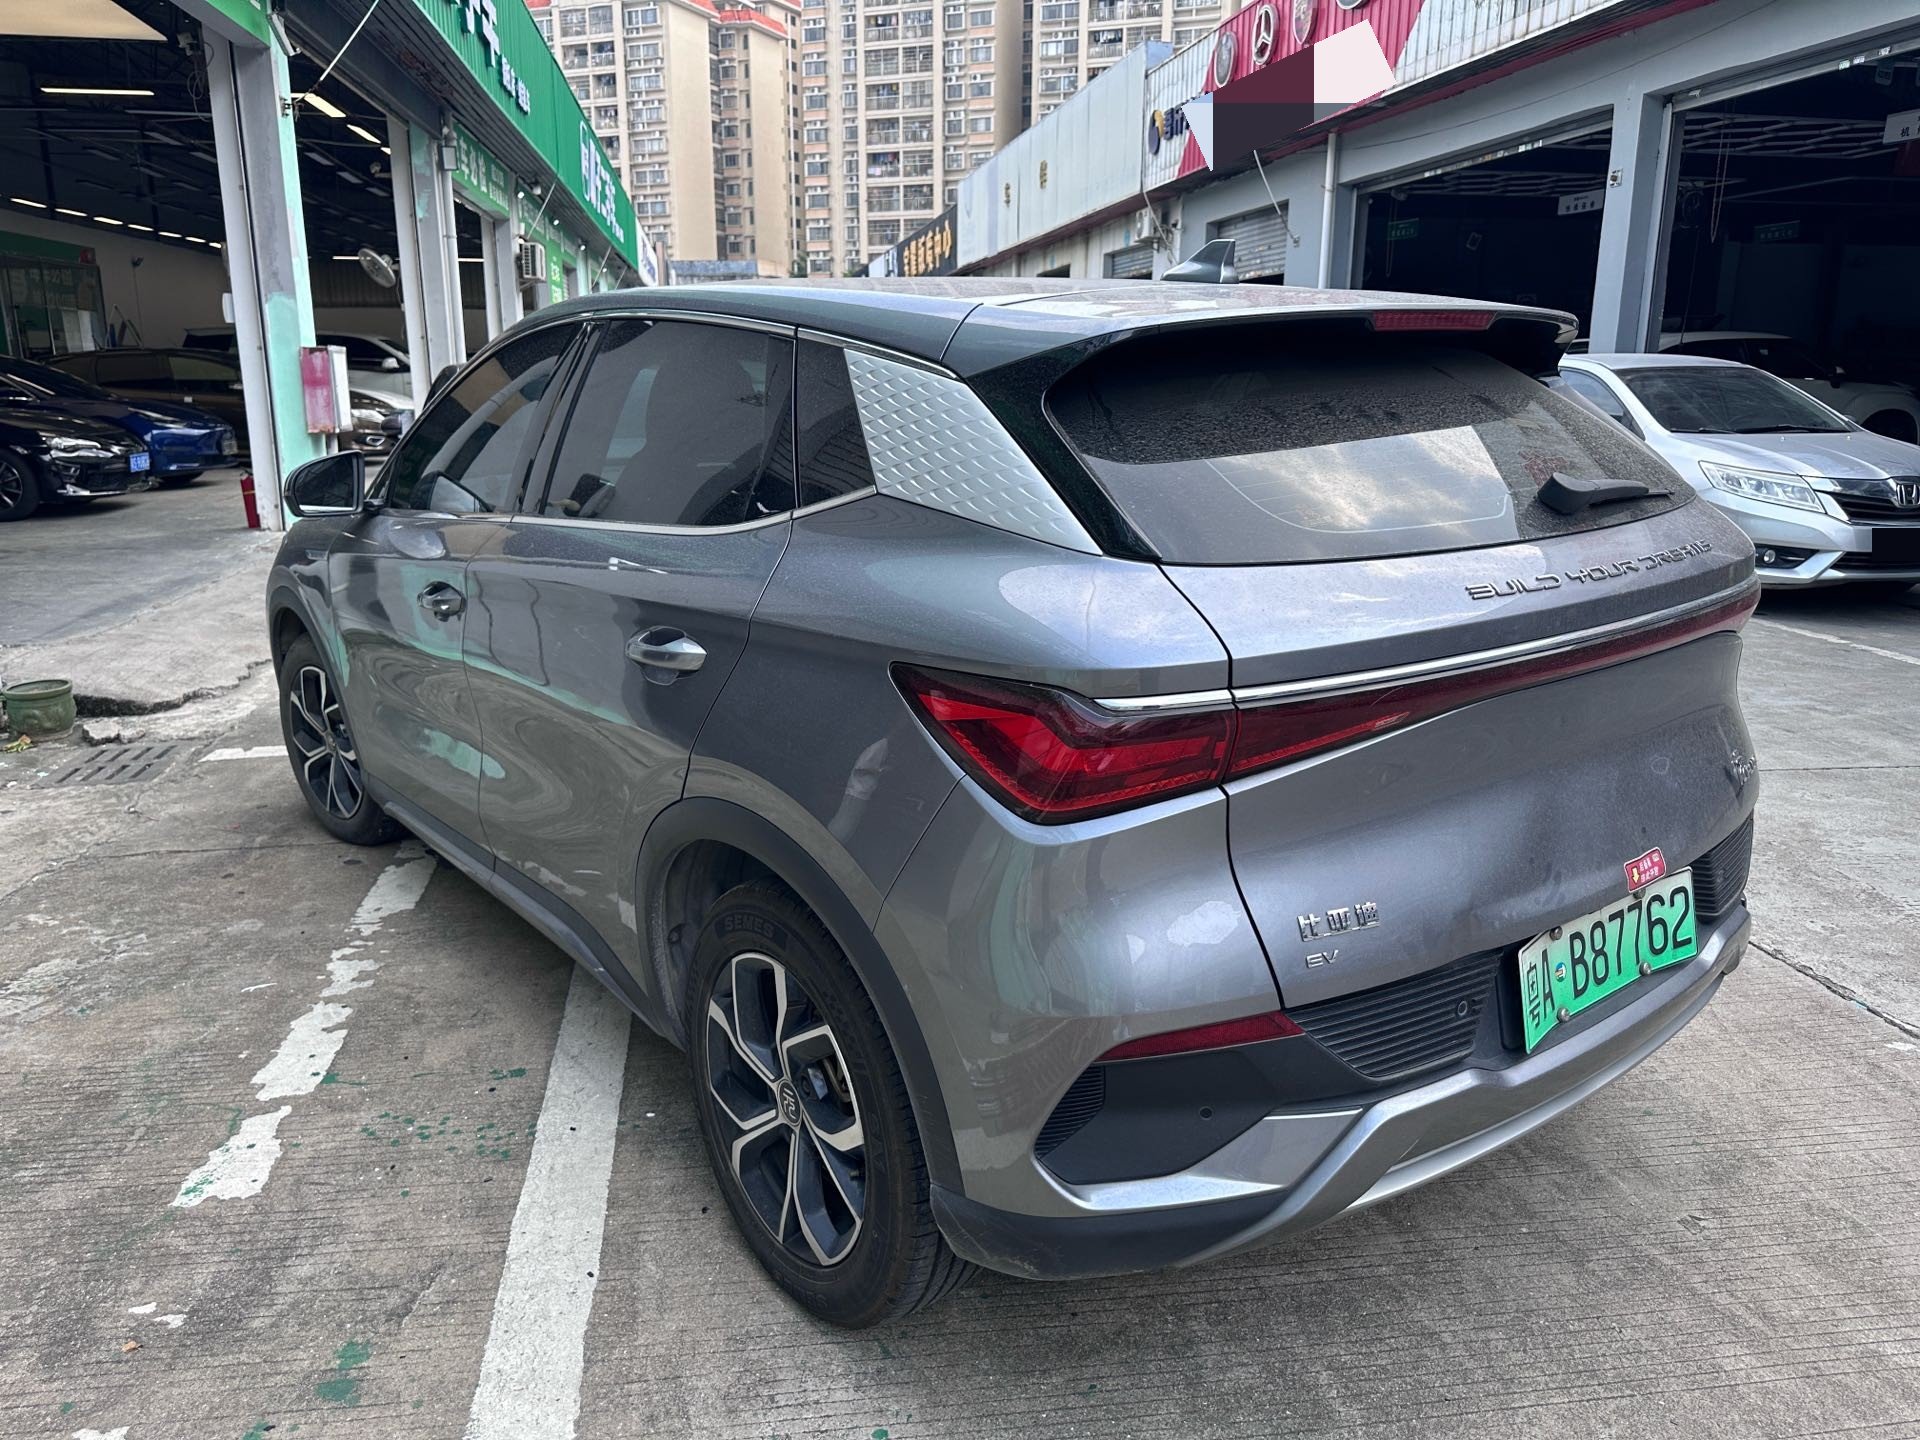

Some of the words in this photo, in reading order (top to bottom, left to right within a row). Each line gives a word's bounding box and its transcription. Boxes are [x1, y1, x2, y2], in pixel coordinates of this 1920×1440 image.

[1465, 573, 1563, 600] BUILD
[1564, 559, 1641, 585] YOUR
[1637, 539, 1713, 571] DREAMS
[1297, 901, 1381, 942] 比亚迪
[1305, 949, 1340, 969] EV
